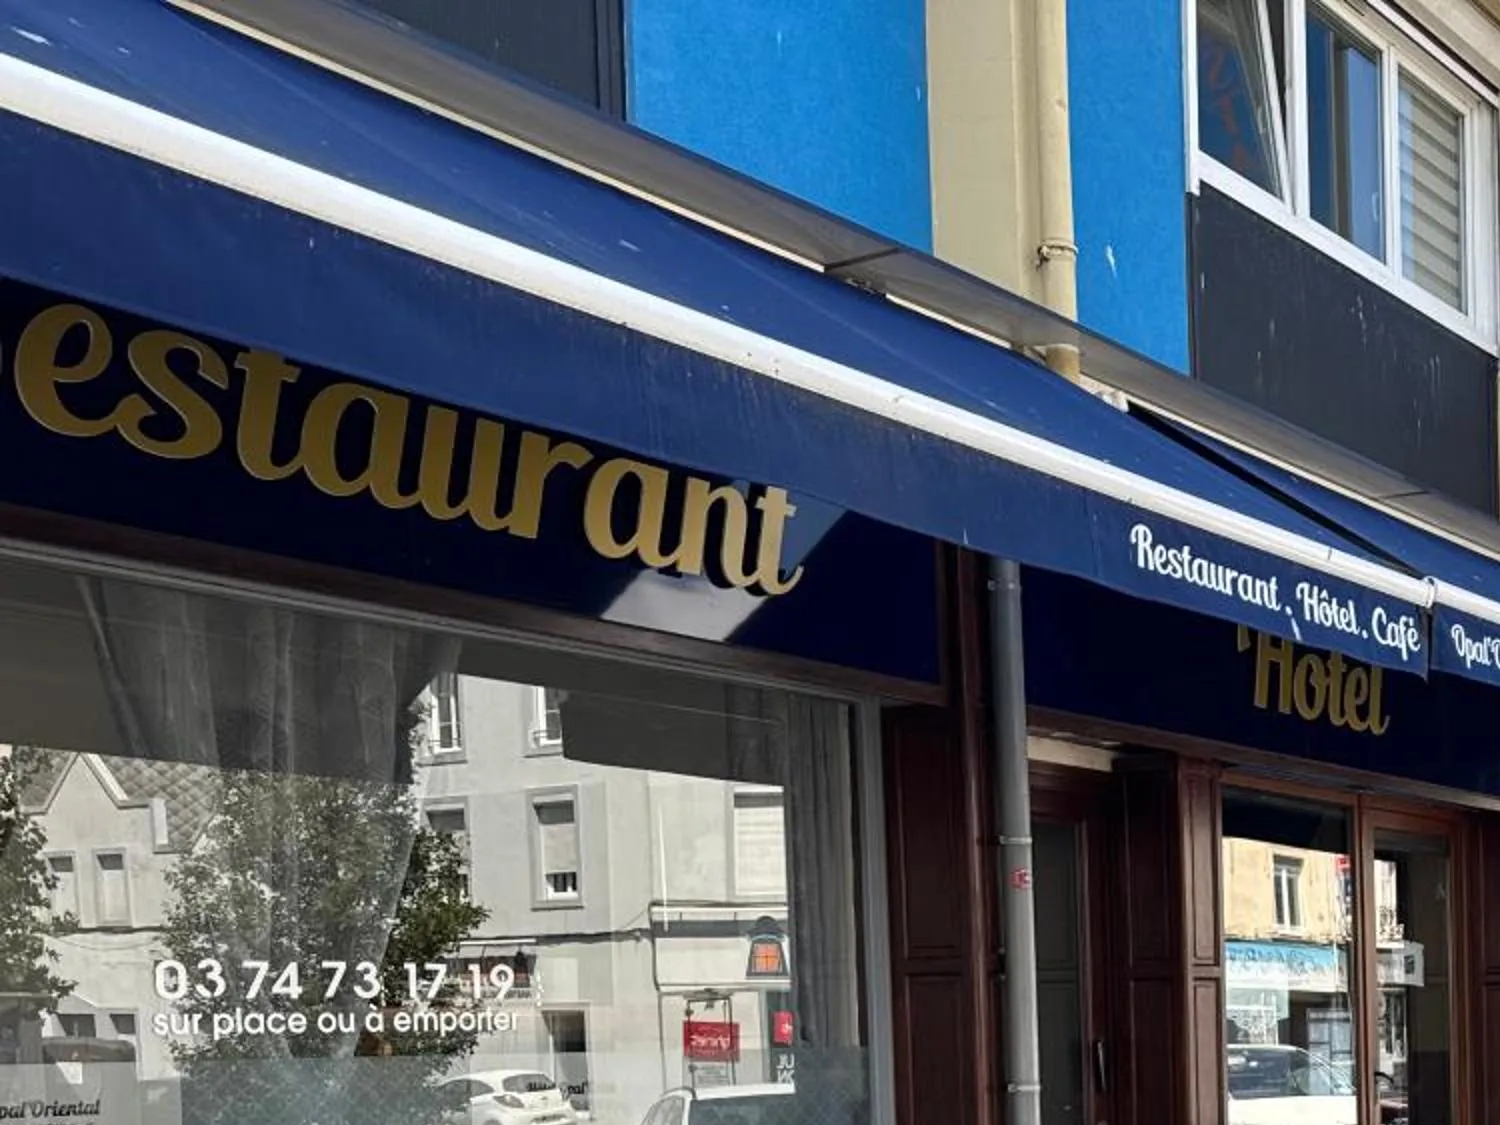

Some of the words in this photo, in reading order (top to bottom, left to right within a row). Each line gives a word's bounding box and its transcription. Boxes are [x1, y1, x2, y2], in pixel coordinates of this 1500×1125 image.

[0, 304, 804, 597] estaurant
[1130, 524, 1281, 612] Restaurant
[1296, 581, 1360, 636] Hôtel
[1371, 607, 1421, 662] Café
[155, 959, 226, 1000] 03
[242, 960, 303, 1000] 74
[322, 960, 382, 1000] 73
[403, 962, 449, 1000] 17
[466, 962, 515, 1000] 19
[153, 1011, 202, 1036] sur
[213, 1007, 307, 1040] place
[317, 1010, 356, 1035] ou
[365, 1004, 385, 1035] à
[393, 1005, 518, 1038] emporter
[0, 1099, 101, 1119] pal'Oriental
